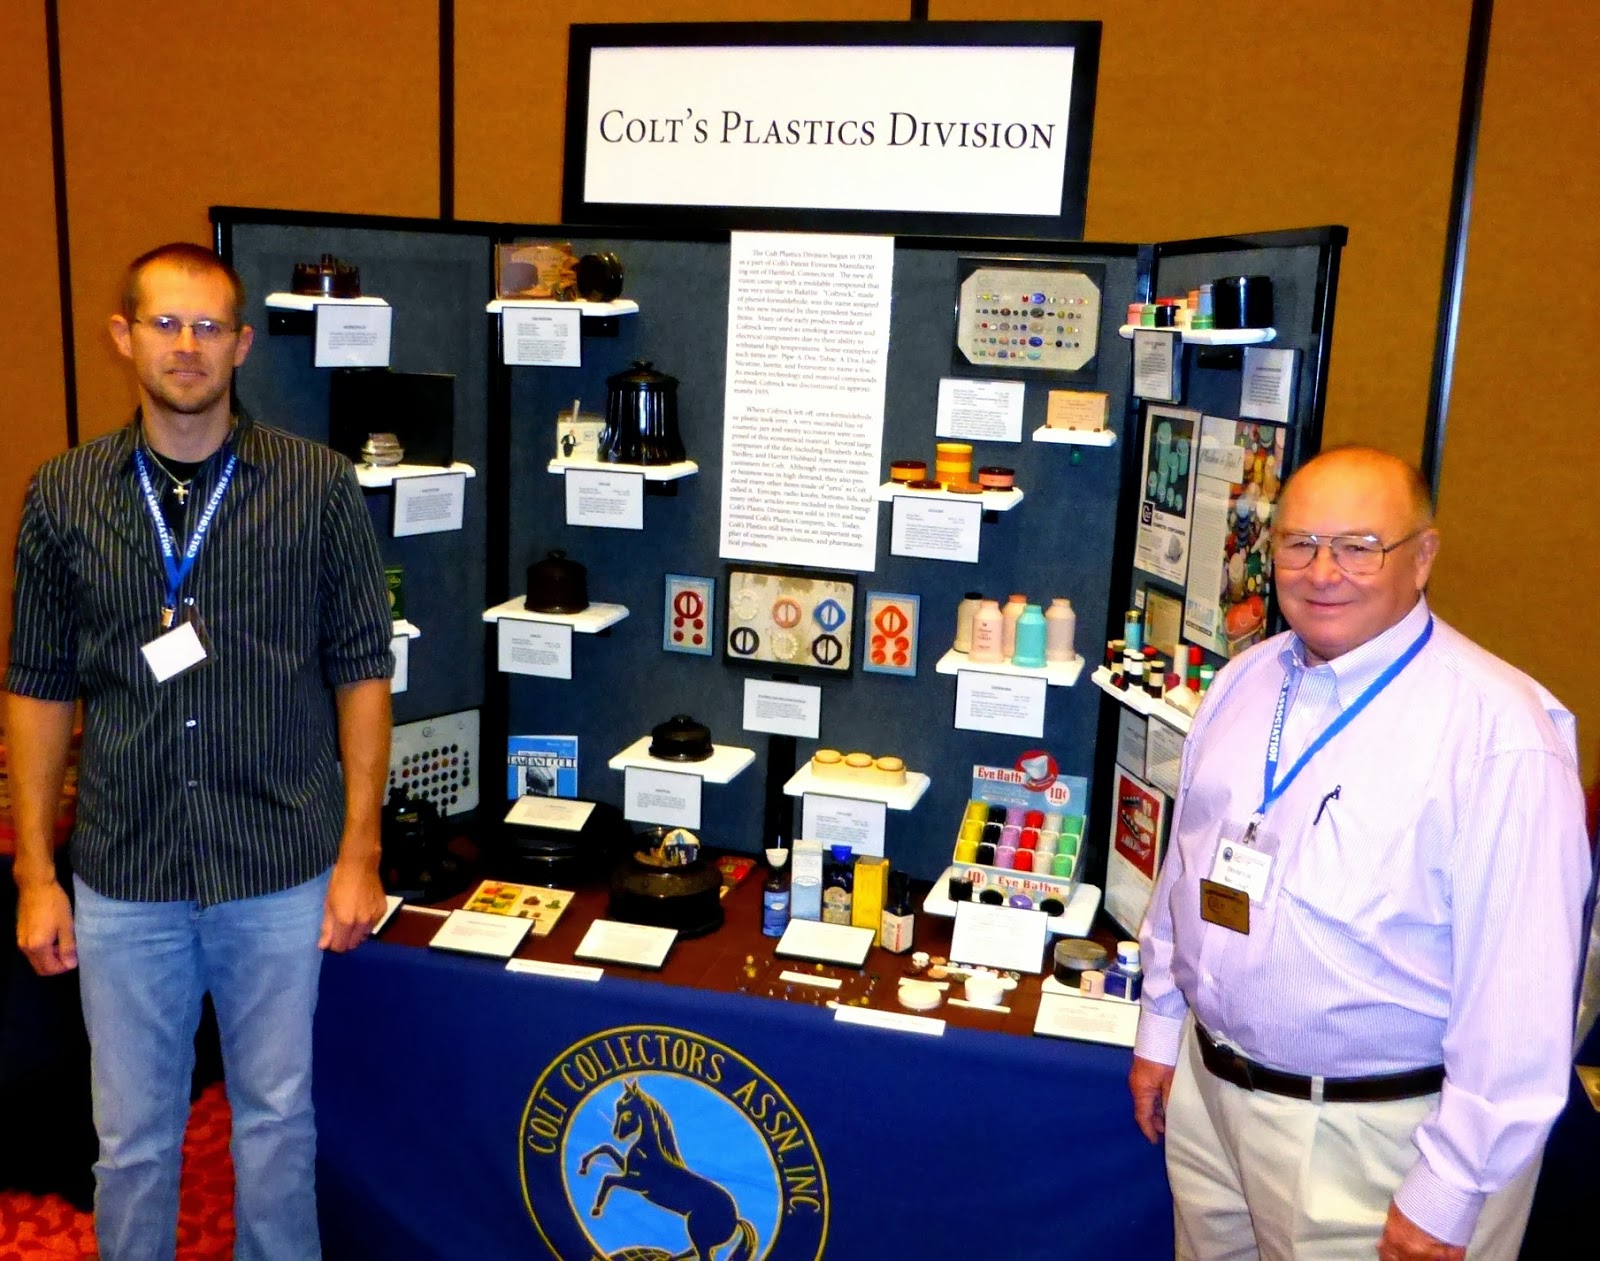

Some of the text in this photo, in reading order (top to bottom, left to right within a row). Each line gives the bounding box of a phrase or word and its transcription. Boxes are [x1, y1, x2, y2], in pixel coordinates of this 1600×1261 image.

[722, 111, 875, 146] PLASTICS
[888, 112, 1056, 149] DIVISION
[147, 494, 173, 557] ASSOCIATION
[186, 532, 203, 559] COLT
[197, 476, 229, 533] COLLECTORS
[1268, 690, 1288, 763] ASSOCIATION
[978, 767, 1022, 783] Eye Bath
[998, 876, 1019, 888] Eye
[1023, 879, 1060, 894] Baths
[527, 1087, 569, 1154] COLT
[560, 1033, 726, 1092] COLLECTORS
[783, 1164, 820, 1215] INC.
